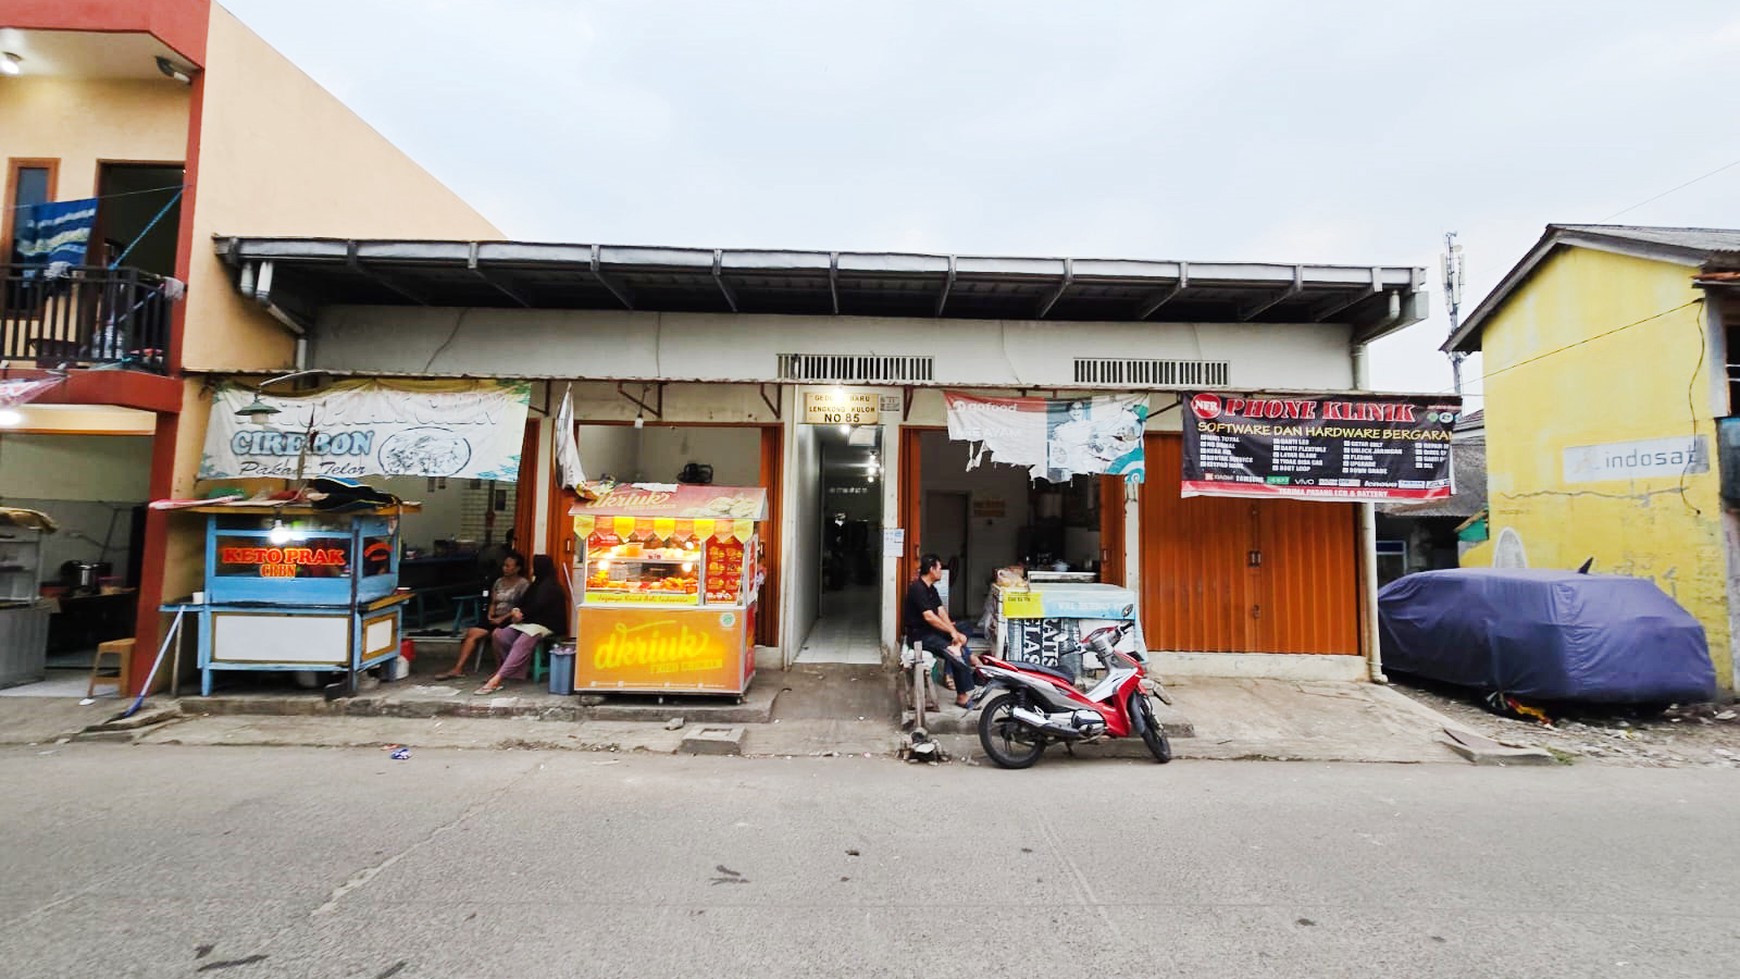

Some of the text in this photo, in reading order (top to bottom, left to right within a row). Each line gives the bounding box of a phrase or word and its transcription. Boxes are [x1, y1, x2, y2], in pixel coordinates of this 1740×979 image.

[967, 402, 1017, 413] gofood
[1225, 398, 1416, 422] PHONE KLINIK
[824, 413, 860, 423] NO 85
[1197, 421, 1271, 436] SOFTWARE
[1273, 425, 1303, 437] DAN
[1305, 425, 1381, 439] HARDWARE
[230, 430, 375, 456] CIREBON
[1606, 445, 1698, 468] indosat
[319, 461, 366, 475] Telor
[222, 547, 283, 564] KETO
[284, 547, 347, 566] PRAK
